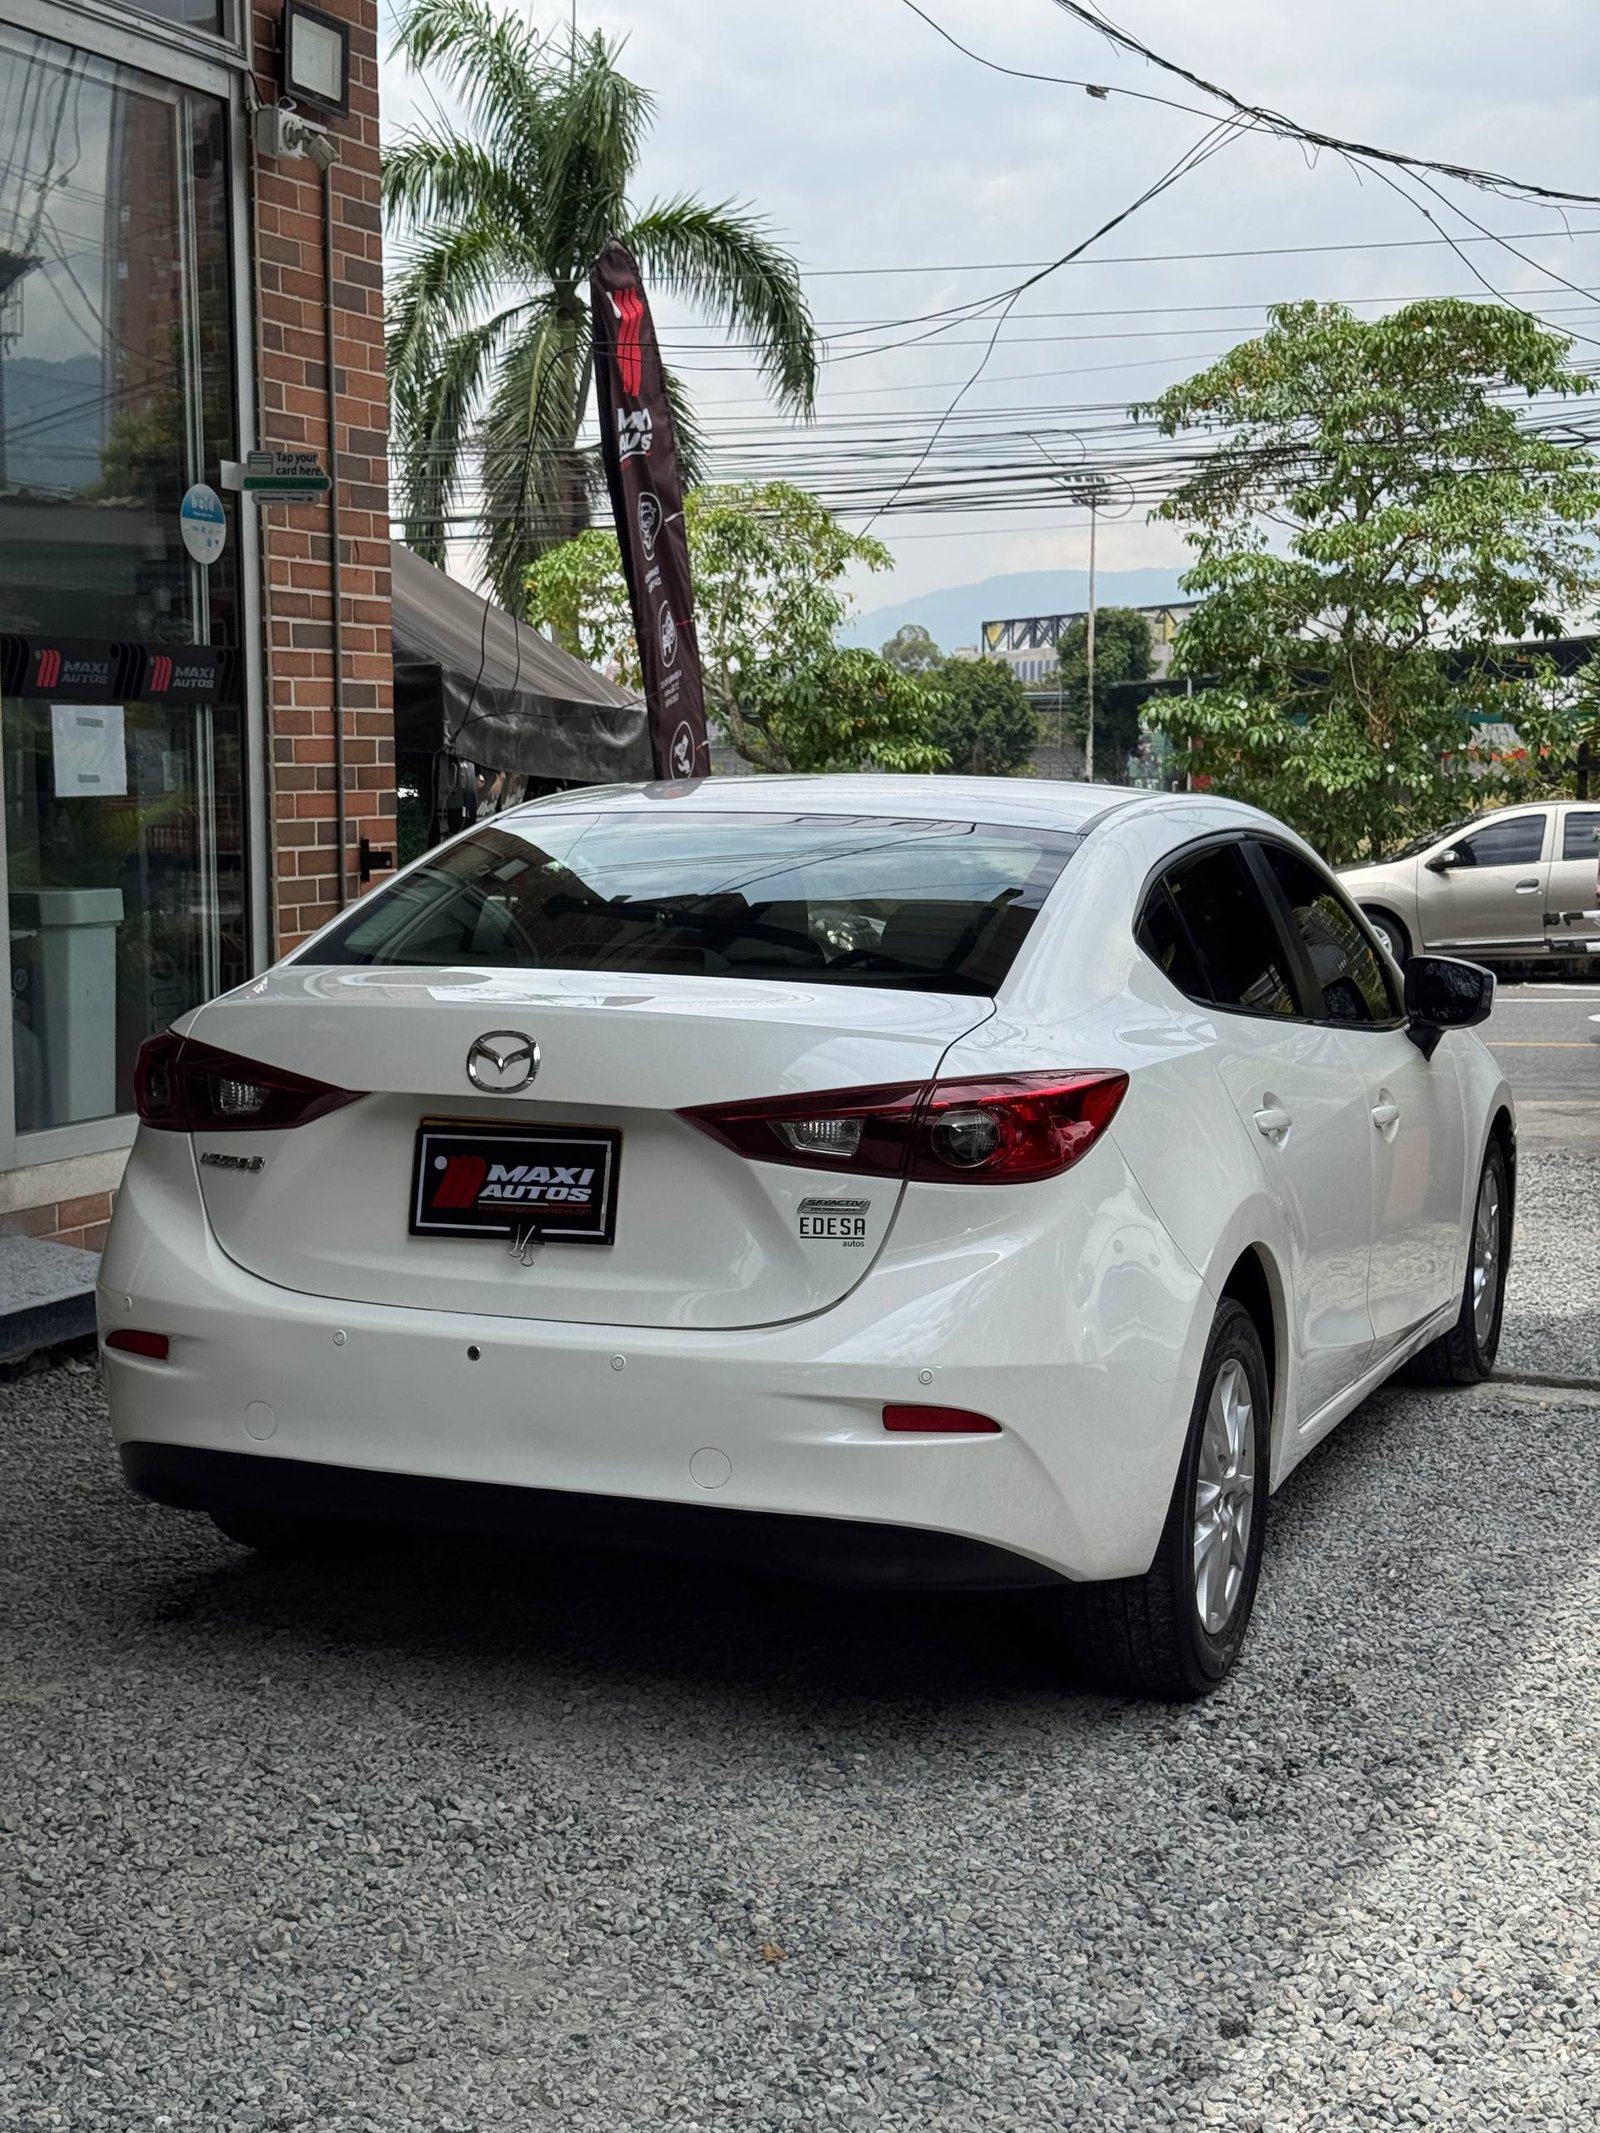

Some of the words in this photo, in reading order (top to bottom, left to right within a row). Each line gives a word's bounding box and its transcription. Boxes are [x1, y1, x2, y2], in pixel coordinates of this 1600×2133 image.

[276, 452, 293, 464] Tap
[295, 453, 317, 464] your
[276, 466, 297, 475] card
[63, 660, 109, 674] MAXI
[174, 666, 215, 679] MAXI
[61, 673, 109, 685] AUTOS
[172, 678, 215, 689] AUTOS
[487, 1164, 595, 1185] MAXI
[478, 1184, 592, 1202] AUTOS
[800, 1217, 865, 1235] EDESA
